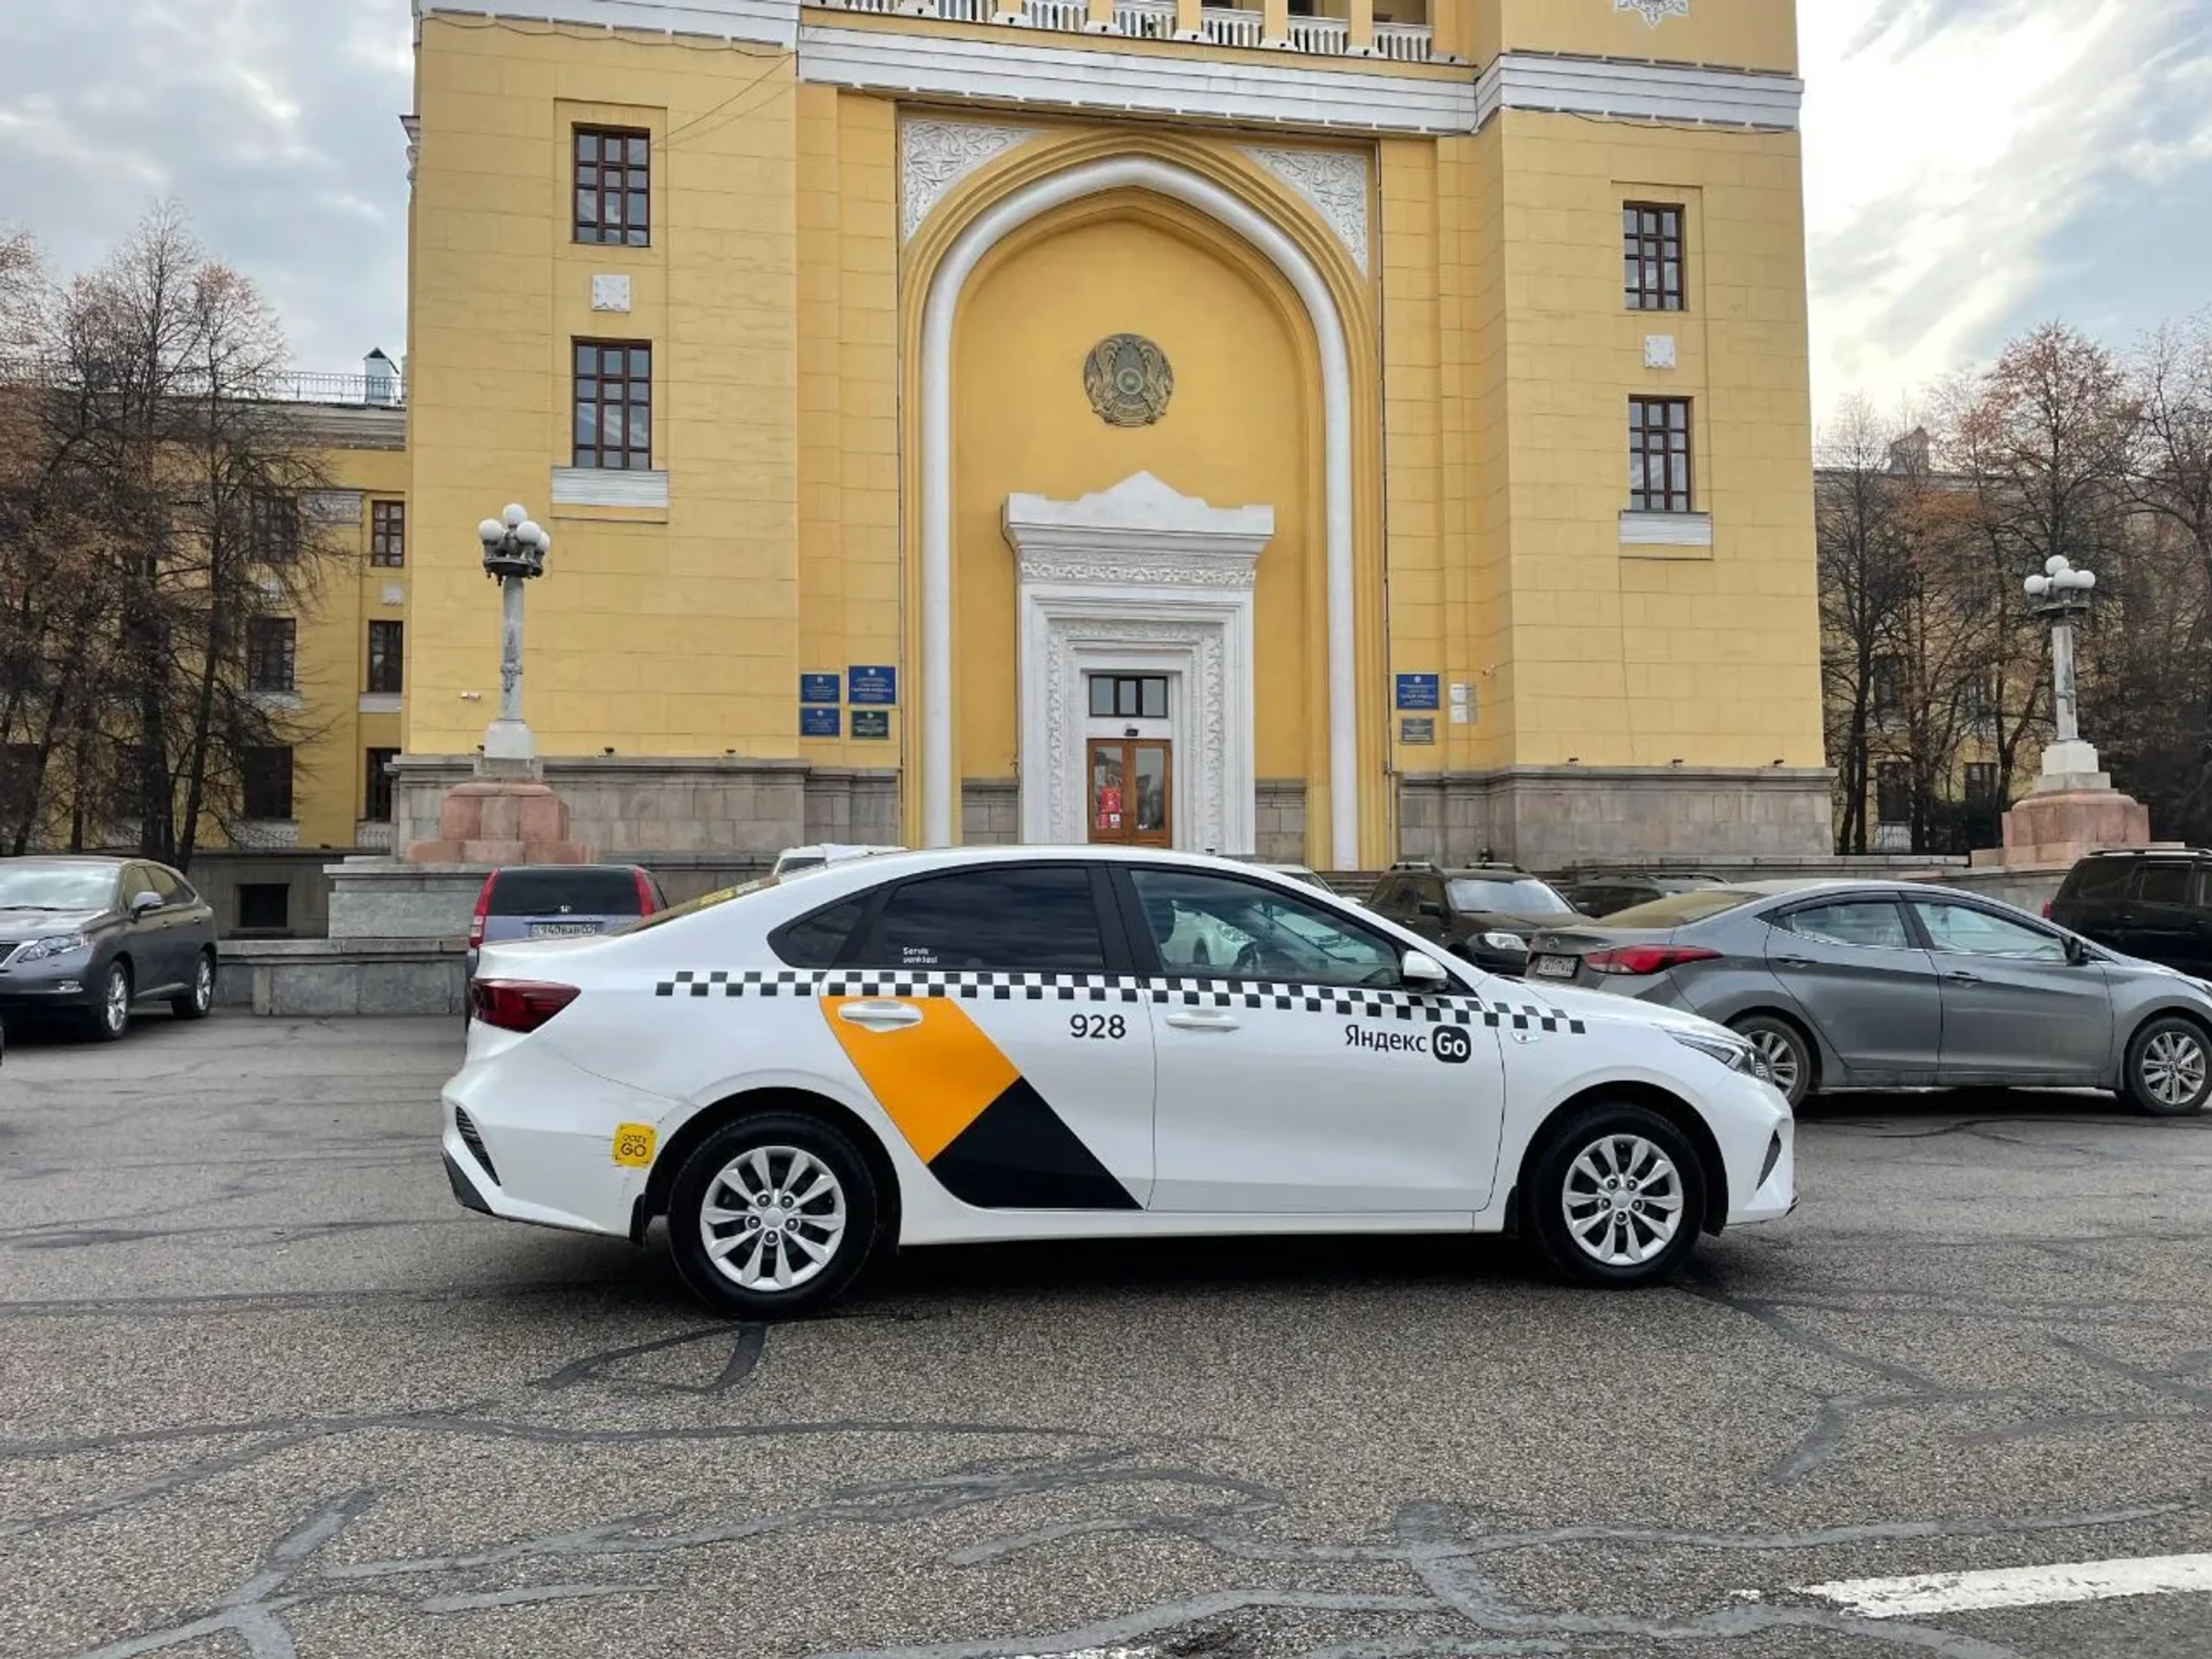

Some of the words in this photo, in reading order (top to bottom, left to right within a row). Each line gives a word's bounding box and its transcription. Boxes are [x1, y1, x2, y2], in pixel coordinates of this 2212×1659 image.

[1070, 1014, 1126, 1039] 928
[1345, 1024, 1427, 1052] Яндекс
[1436, 1032, 1467, 1057] Go
[620, 1142, 647, 1157] GO
